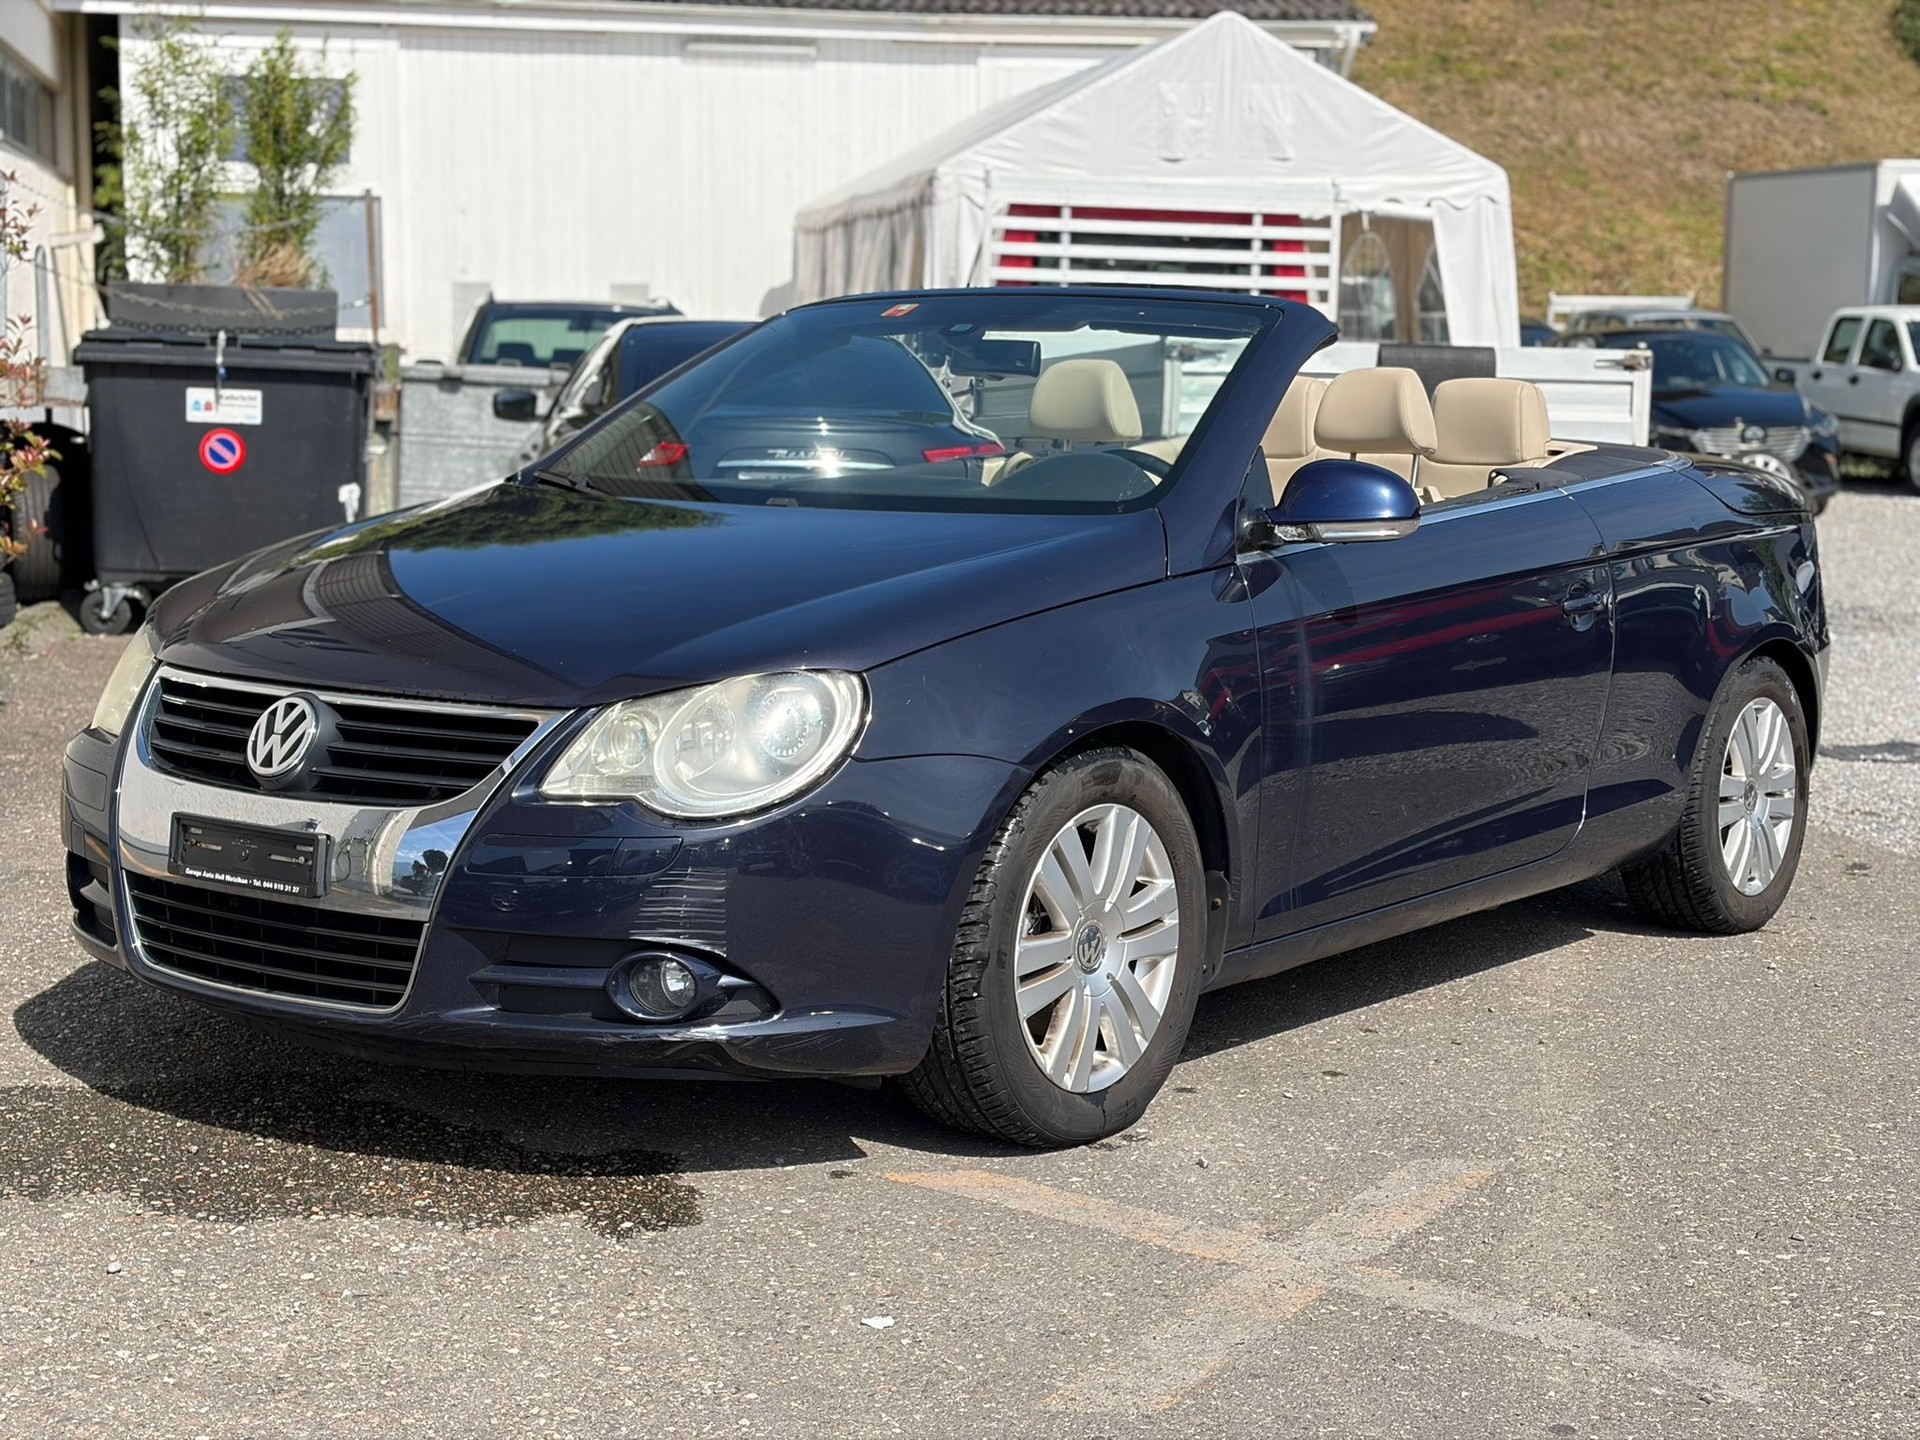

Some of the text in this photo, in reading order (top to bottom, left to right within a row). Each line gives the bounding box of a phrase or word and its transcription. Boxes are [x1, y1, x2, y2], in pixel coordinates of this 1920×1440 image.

[246, 697, 315, 776] VW
[186, 868, 202, 877] Garage
[202, 870, 214, 878] Auto
